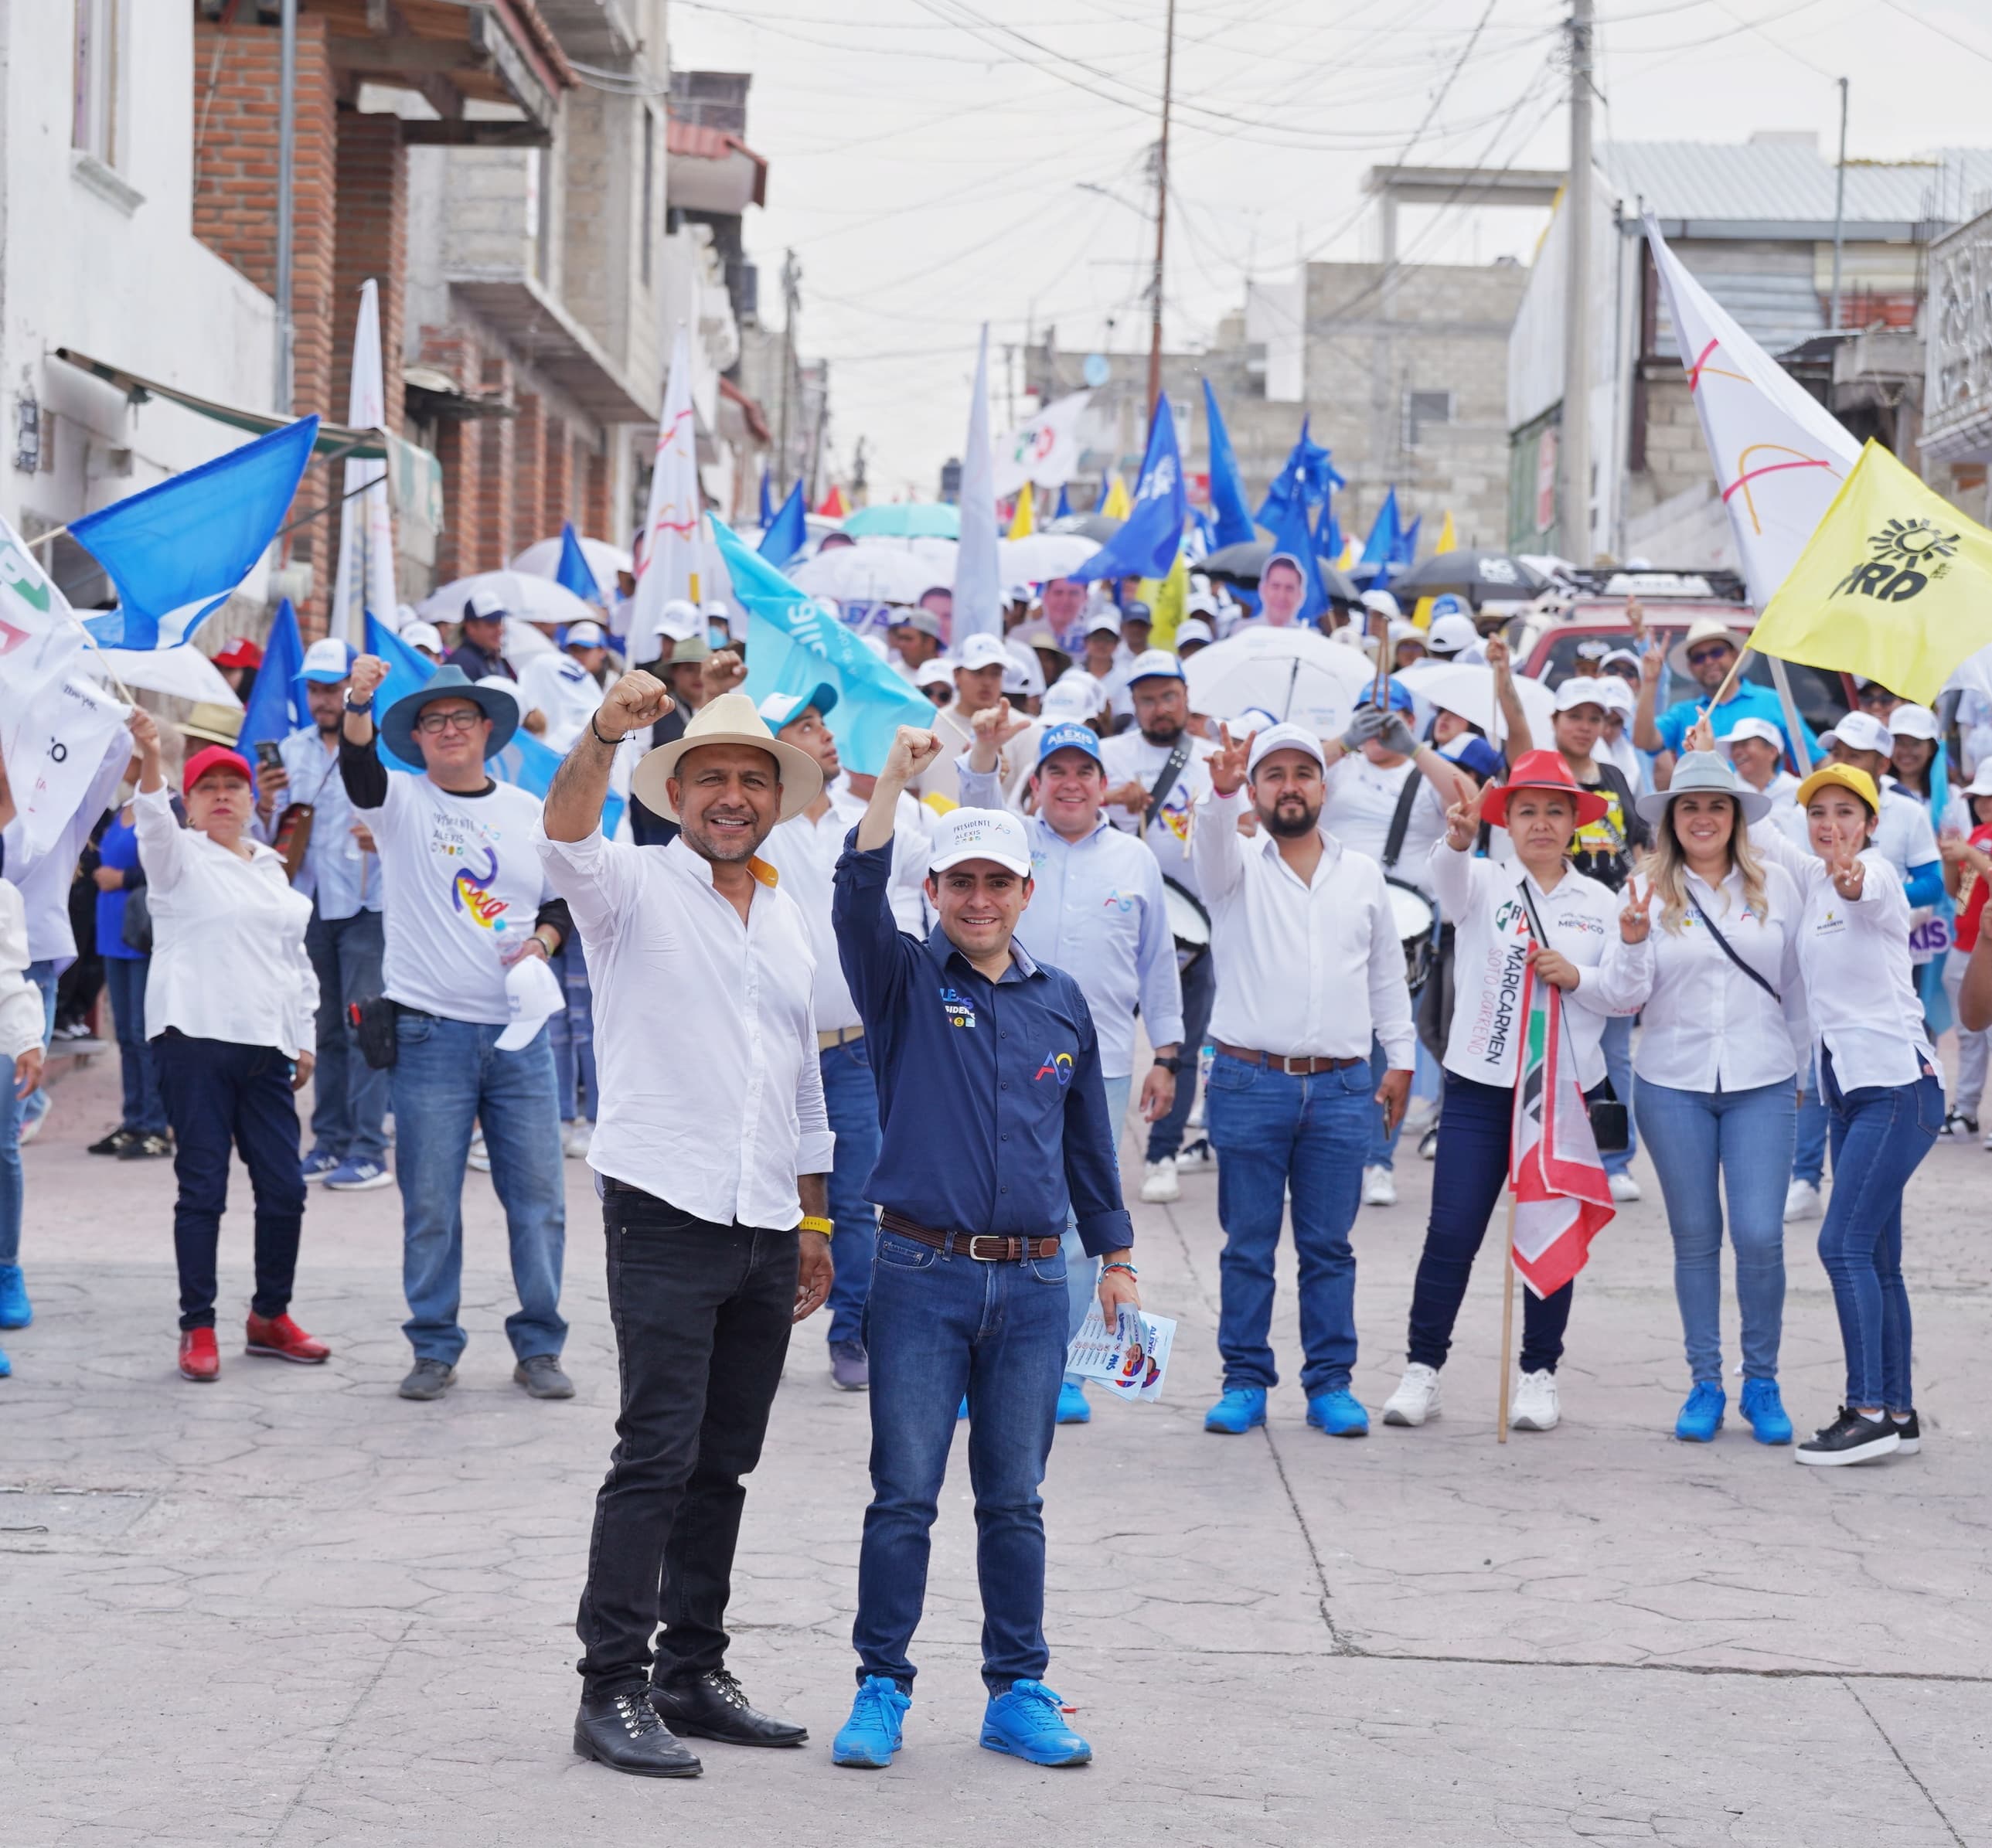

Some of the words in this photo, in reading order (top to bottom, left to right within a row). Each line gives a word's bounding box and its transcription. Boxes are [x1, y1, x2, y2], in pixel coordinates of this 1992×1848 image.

[955, 829, 981, 840] ALEXIS
[1483, 948, 1503, 986] SOTO
[1484, 944, 1526, 1066] MARICARMEN
[1035, 1050, 1073, 1085] AG
